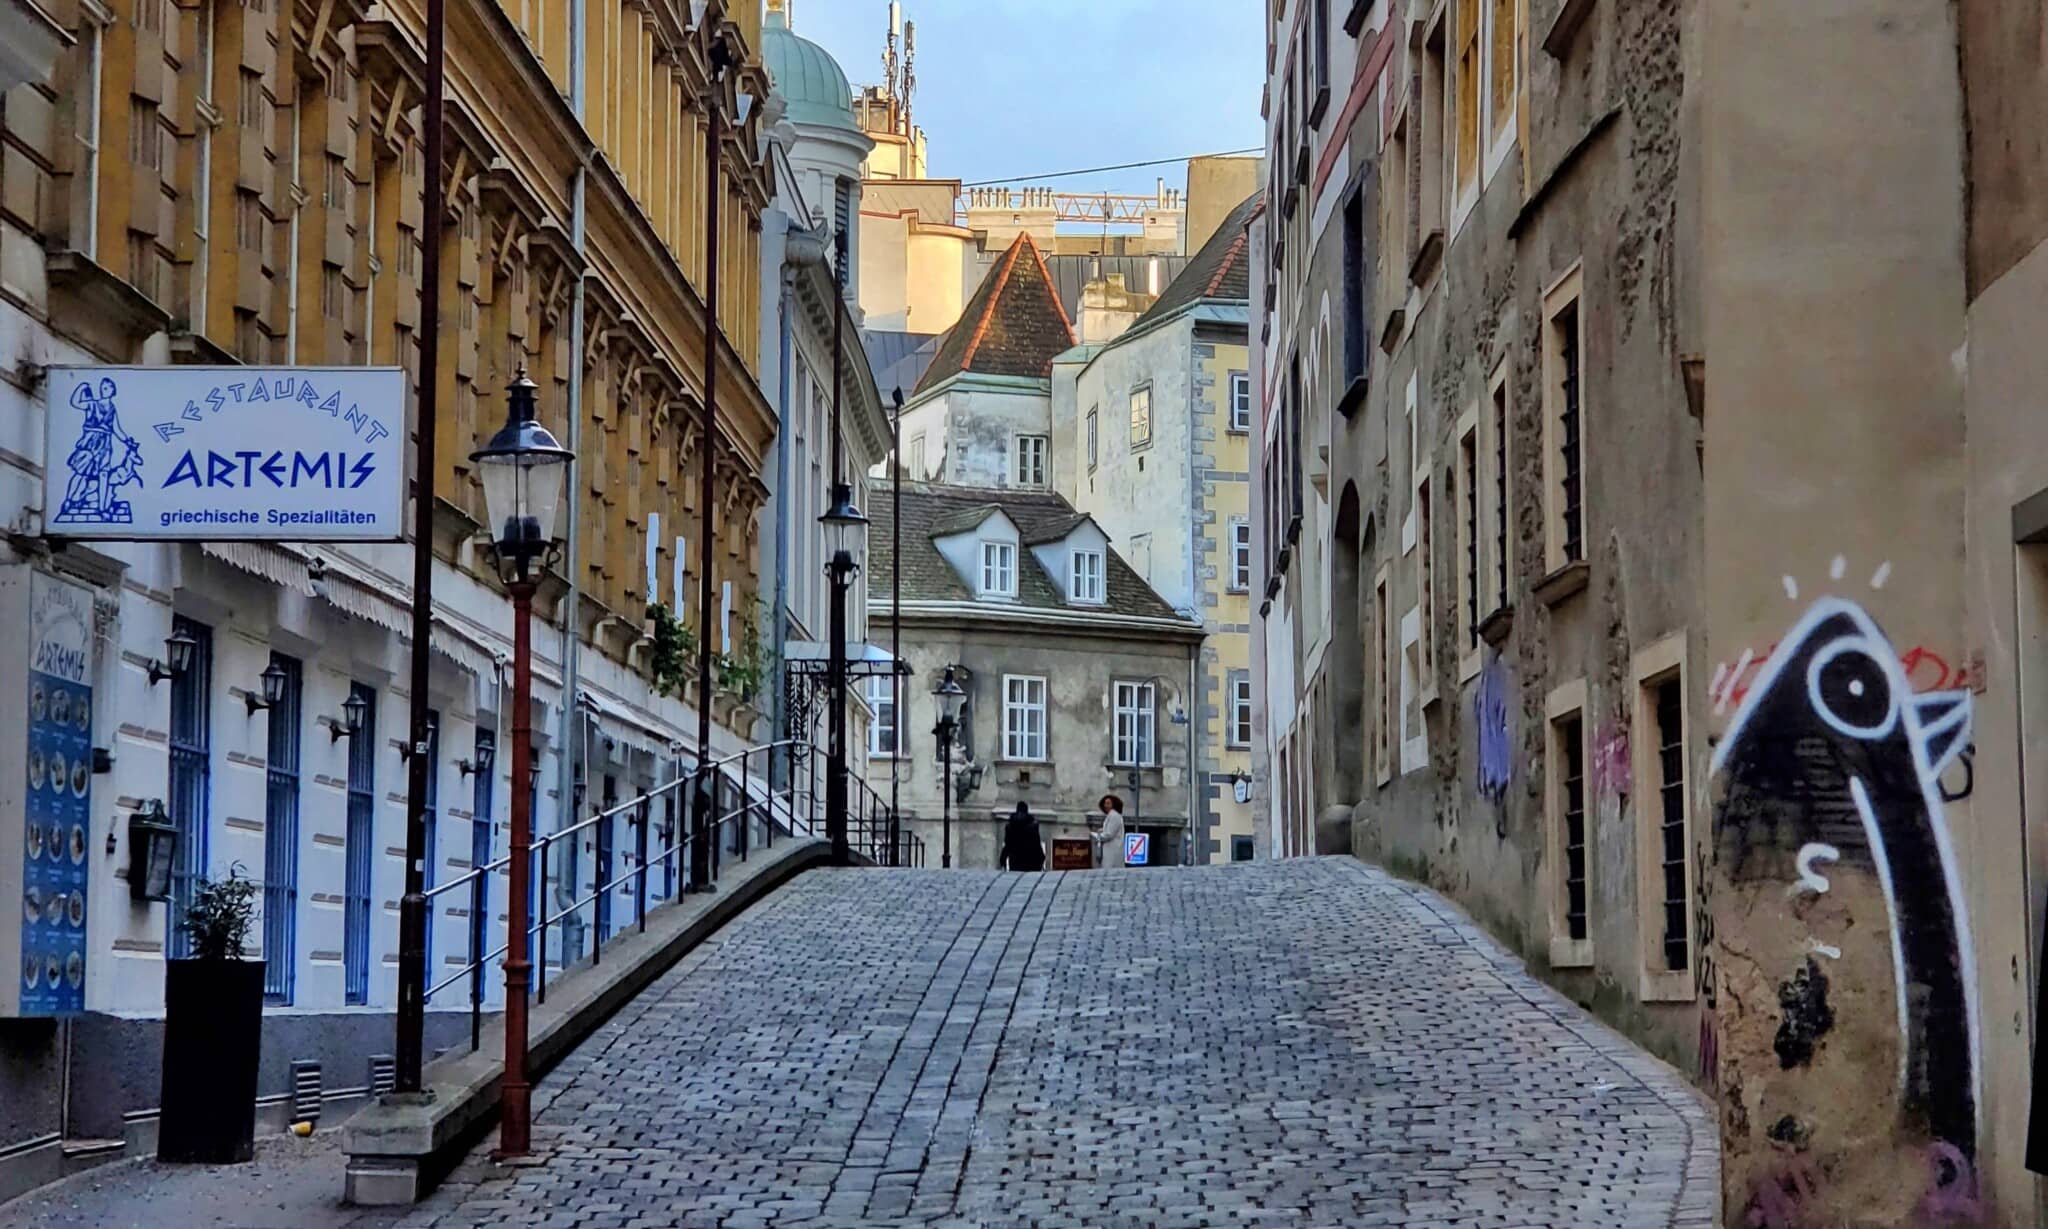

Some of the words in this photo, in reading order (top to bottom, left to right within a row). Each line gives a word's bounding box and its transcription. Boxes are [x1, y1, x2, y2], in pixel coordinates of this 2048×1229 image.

[153, 377, 389, 444] RESTAURANT
[161, 449, 377, 489] ARTEMIS
[160, 508, 260, 527] griechische
[267, 508, 376, 527] Spezialitäten
[36, 640, 85, 681] ARTEMIS
